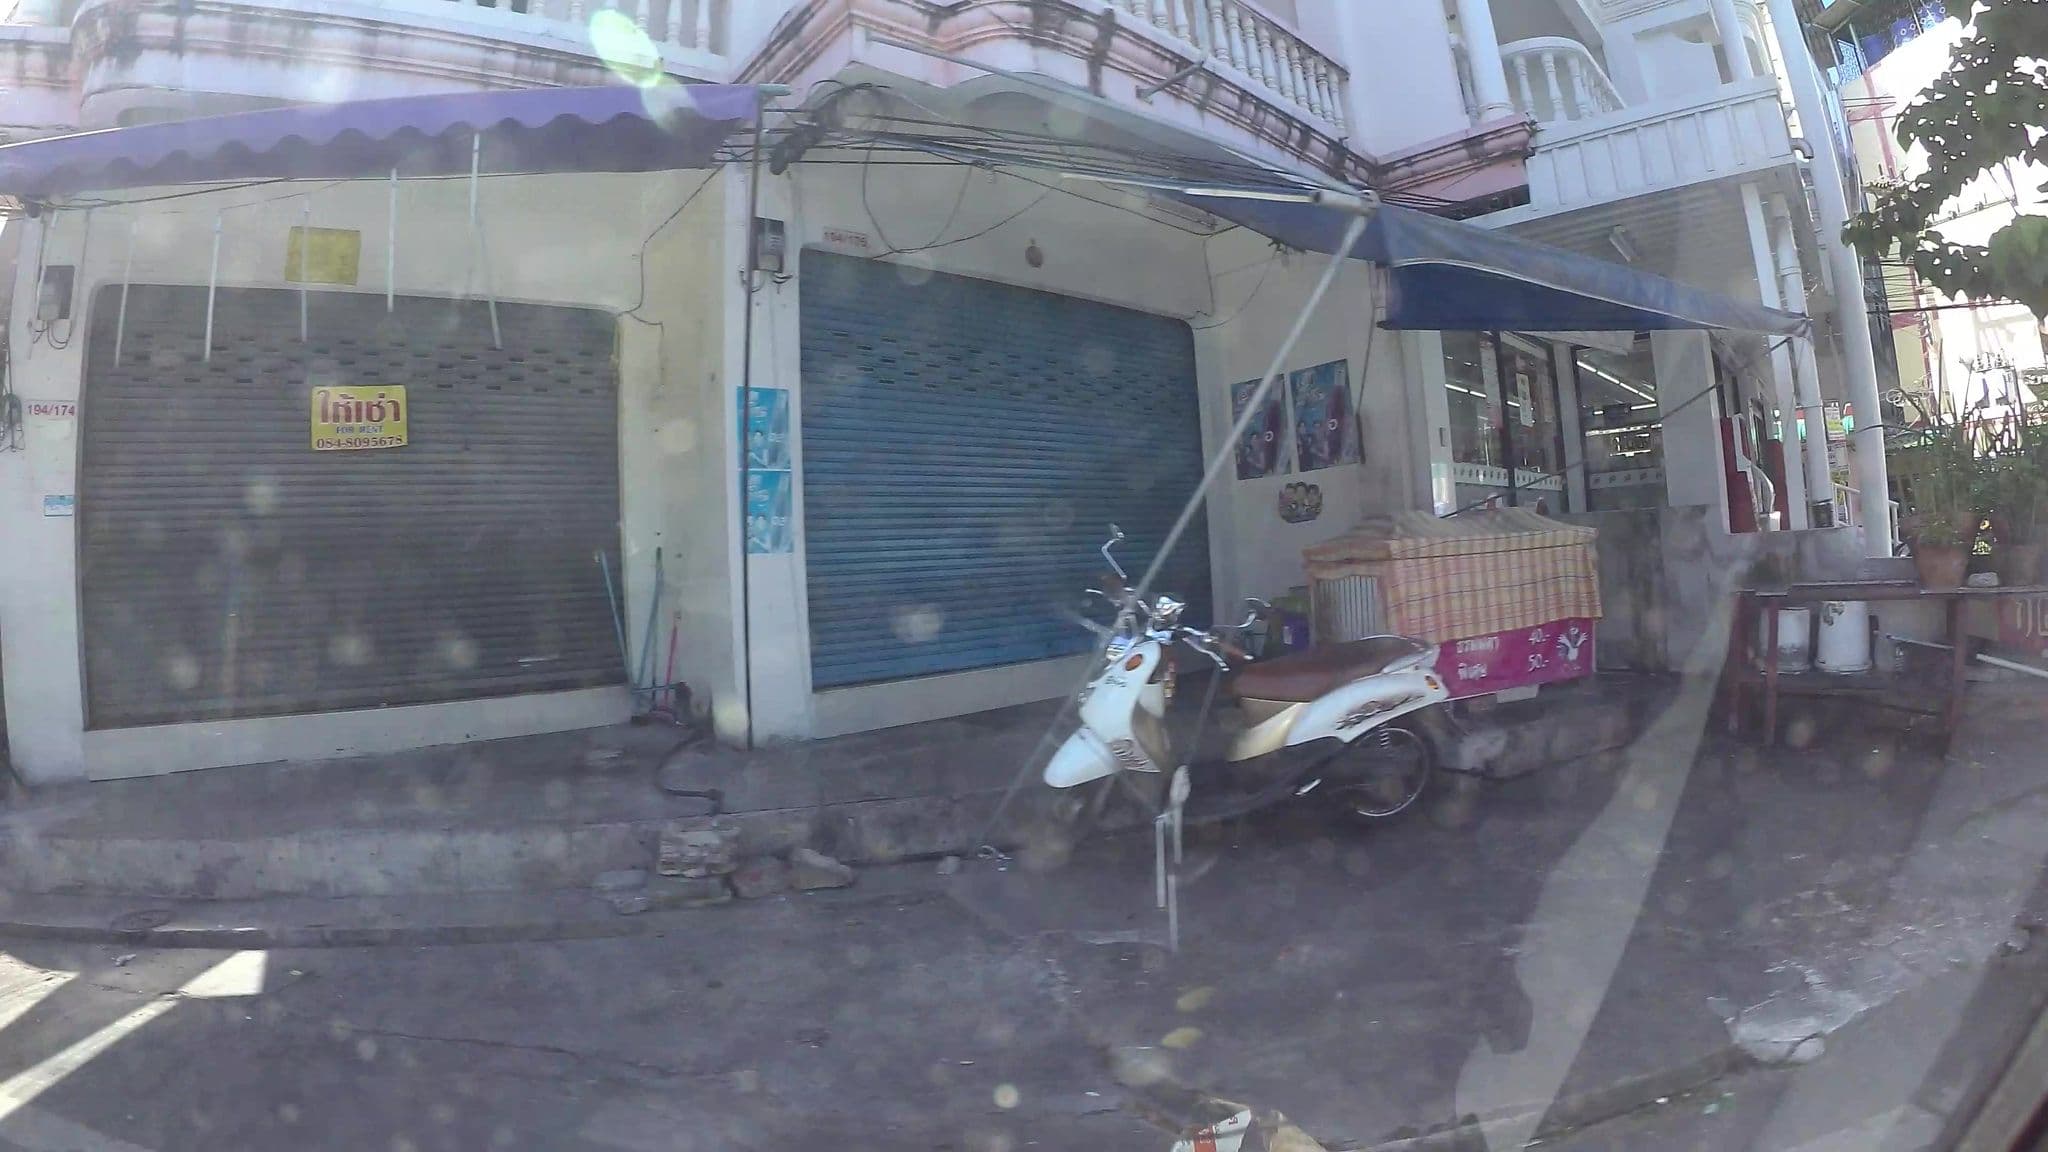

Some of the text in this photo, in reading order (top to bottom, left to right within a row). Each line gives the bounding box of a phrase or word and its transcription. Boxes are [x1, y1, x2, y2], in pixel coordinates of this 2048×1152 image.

[27, 404, 76, 416] 194/174
[317, 389, 401, 423] ให้เช่า
[336, 425, 383, 434] FOR RENT
